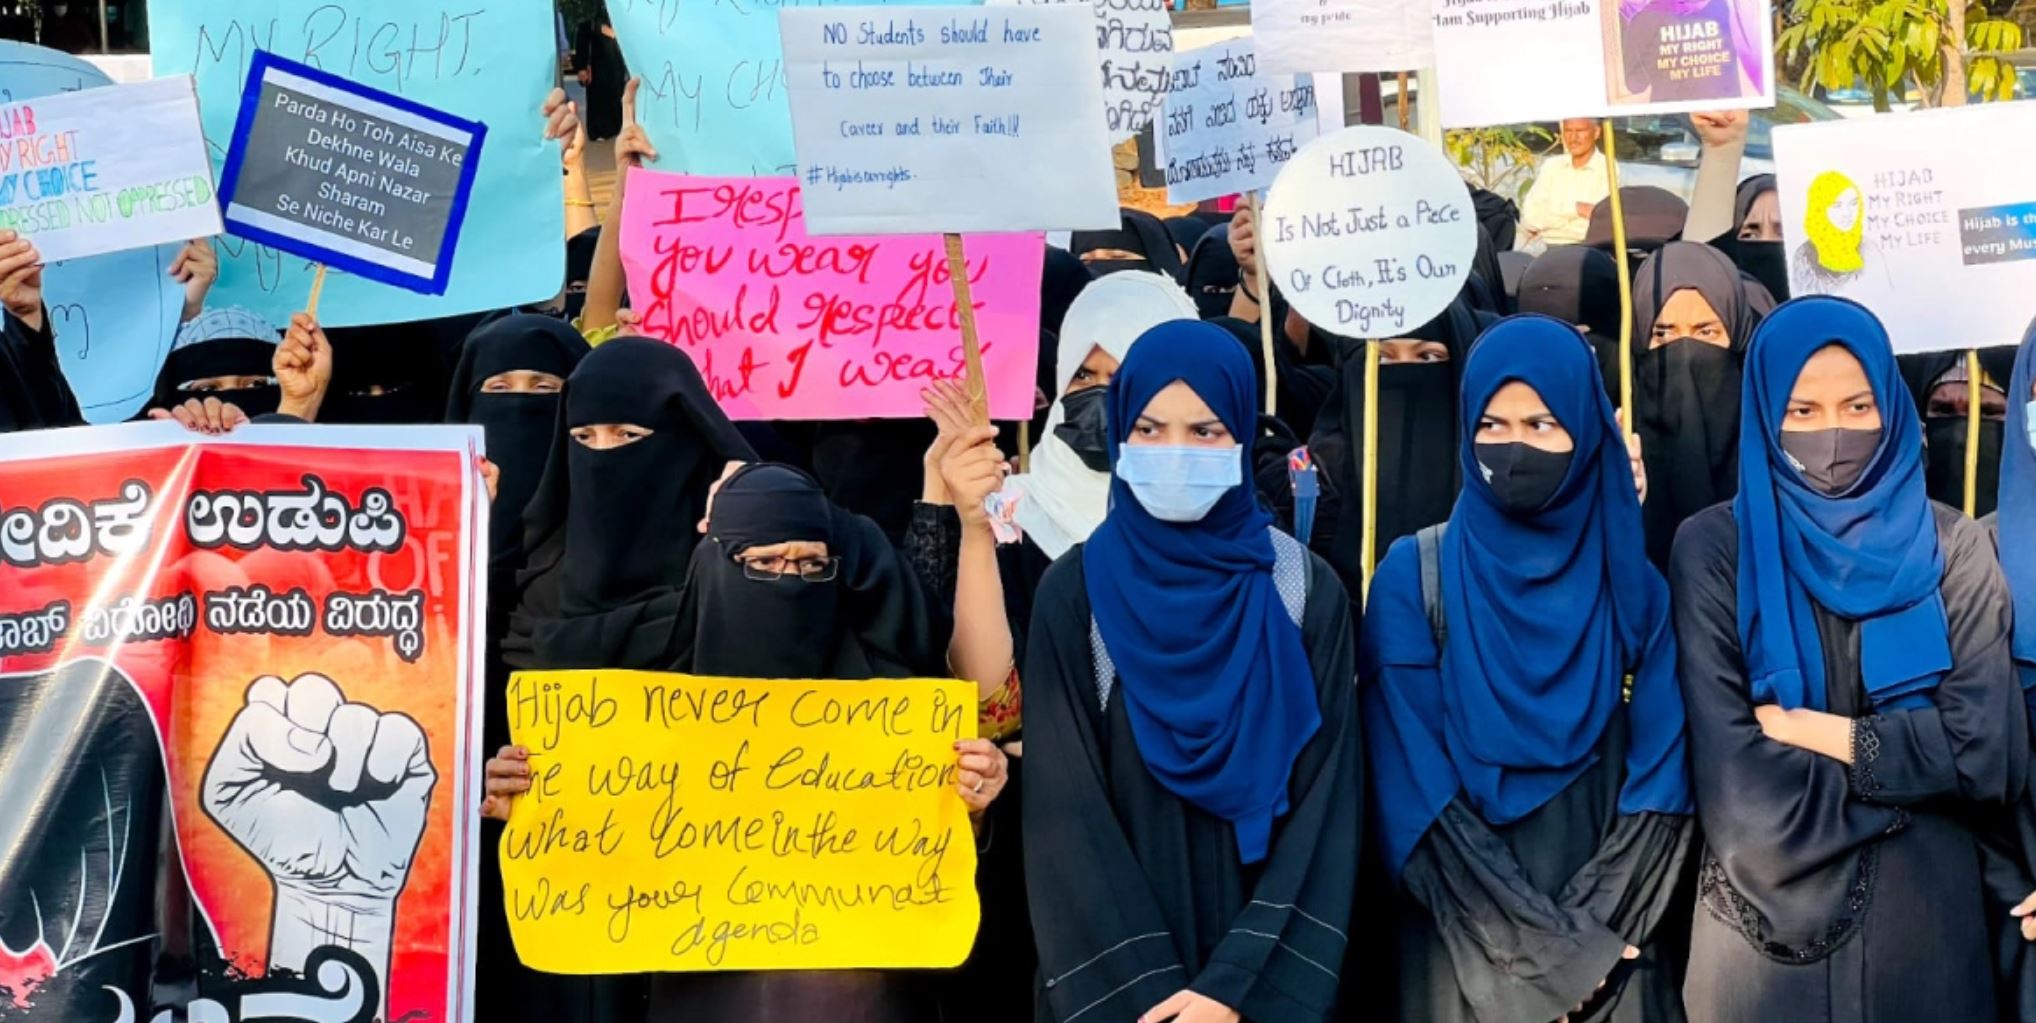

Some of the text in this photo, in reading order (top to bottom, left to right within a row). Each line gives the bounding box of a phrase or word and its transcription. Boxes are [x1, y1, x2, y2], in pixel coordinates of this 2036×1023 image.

[823, 22, 848, 45] NO
[856, 18, 925, 46] Students
[1004, 17, 1042, 42] have
[1466, 8, 1547, 26] Supporting
[1549, 1, 1591, 19] Hijab
[1660, 21, 1719, 42] HIJAB
[1657, 50, 1731, 69] MY CHOICE
[1659, 39, 1722, 55] MY RIGHT
[823, 60, 841, 89] to
[850, 59, 895, 89] choose
[908, 61, 962, 88] between
[1670, 64, 1721, 80] MY LIFE
[0, 105, 36, 139] JAB
[274, 92, 463, 167] Parda Ho Toh Aisa Ke
[895, 115, 921, 137] and
[932, 114, 960, 135] their
[16, 130, 79, 169] RIGHT
[307, 127, 421, 178] Dekhne Wala
[1329, 145, 1404, 178] HIJAB
[23, 161, 99, 200] CHOICE
[284, 145, 431, 206] Khud Apni Nazar
[1873, 167, 1934, 189] HIJAB
[75, 193, 114, 224] NOT
[117, 175, 212, 218] OPPRESSED
[317, 181, 386, 217] Sharam
[276, 193, 414, 250] Se Niche Kar Le
[1274, 217, 1294, 243] Is
[1302, 211, 1341, 239] Not
[1345, 205, 1388, 234] Just
[1396, 214, 1411, 230] a
[1964, 215, 2002, 233] Hijab
[2005, 213, 2019, 228] is
[748, 242, 880, 284] wear
[1964, 241, 2006, 256] every
[796, 291, 986, 348] respect
[1335, 297, 1405, 332] Dignity
[701, 346, 771, 402] hat
[187, 478, 402, 548] ಉಡುಪಿ
[208, 588, 311, 629] ನಡೆಯ
[511, 677, 617, 750] Hijab
[643, 684, 770, 728] never
[708, 739, 750, 793] of
